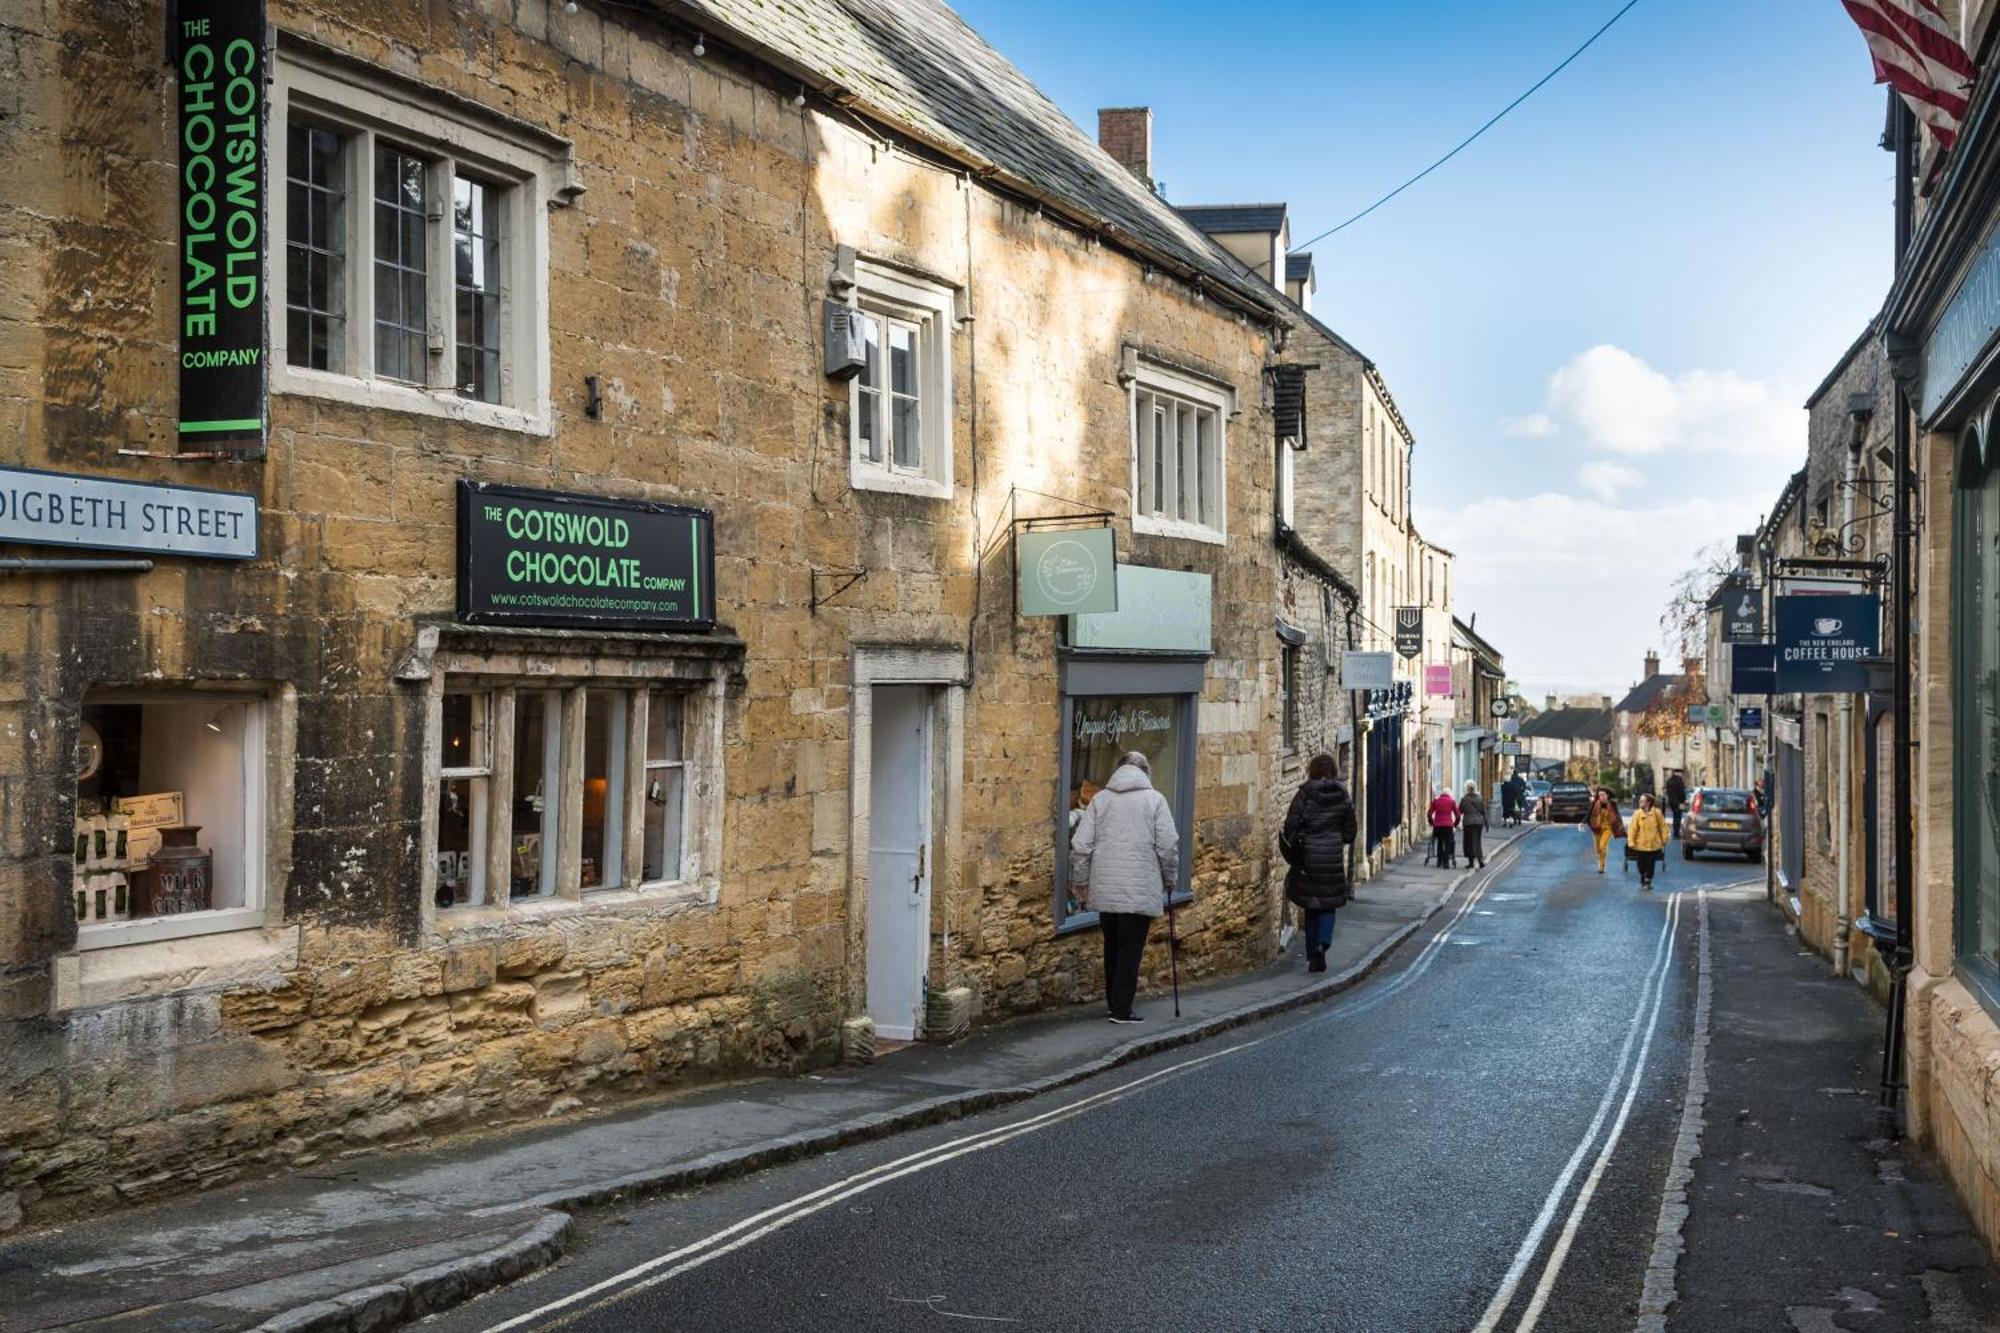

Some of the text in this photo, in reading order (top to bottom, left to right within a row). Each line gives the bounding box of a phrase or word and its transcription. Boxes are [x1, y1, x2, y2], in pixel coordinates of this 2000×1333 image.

[183, 19, 211, 37] THE
[183, 43, 217, 337] CHOCOLATE
[224, 37, 258, 309] COTSWOLD
[182, 348, 260, 369] COMPANY
[142, 502, 244, 539] STREET
[484, 505, 629, 548] THE COTSWOLD
[506, 550, 686, 592] CHOCOLATE COMPANY
[490, 593, 679, 612] www.cotswoldchocolatecompany.com
[1784, 647, 1870, 661] COFFEE HOUSE
